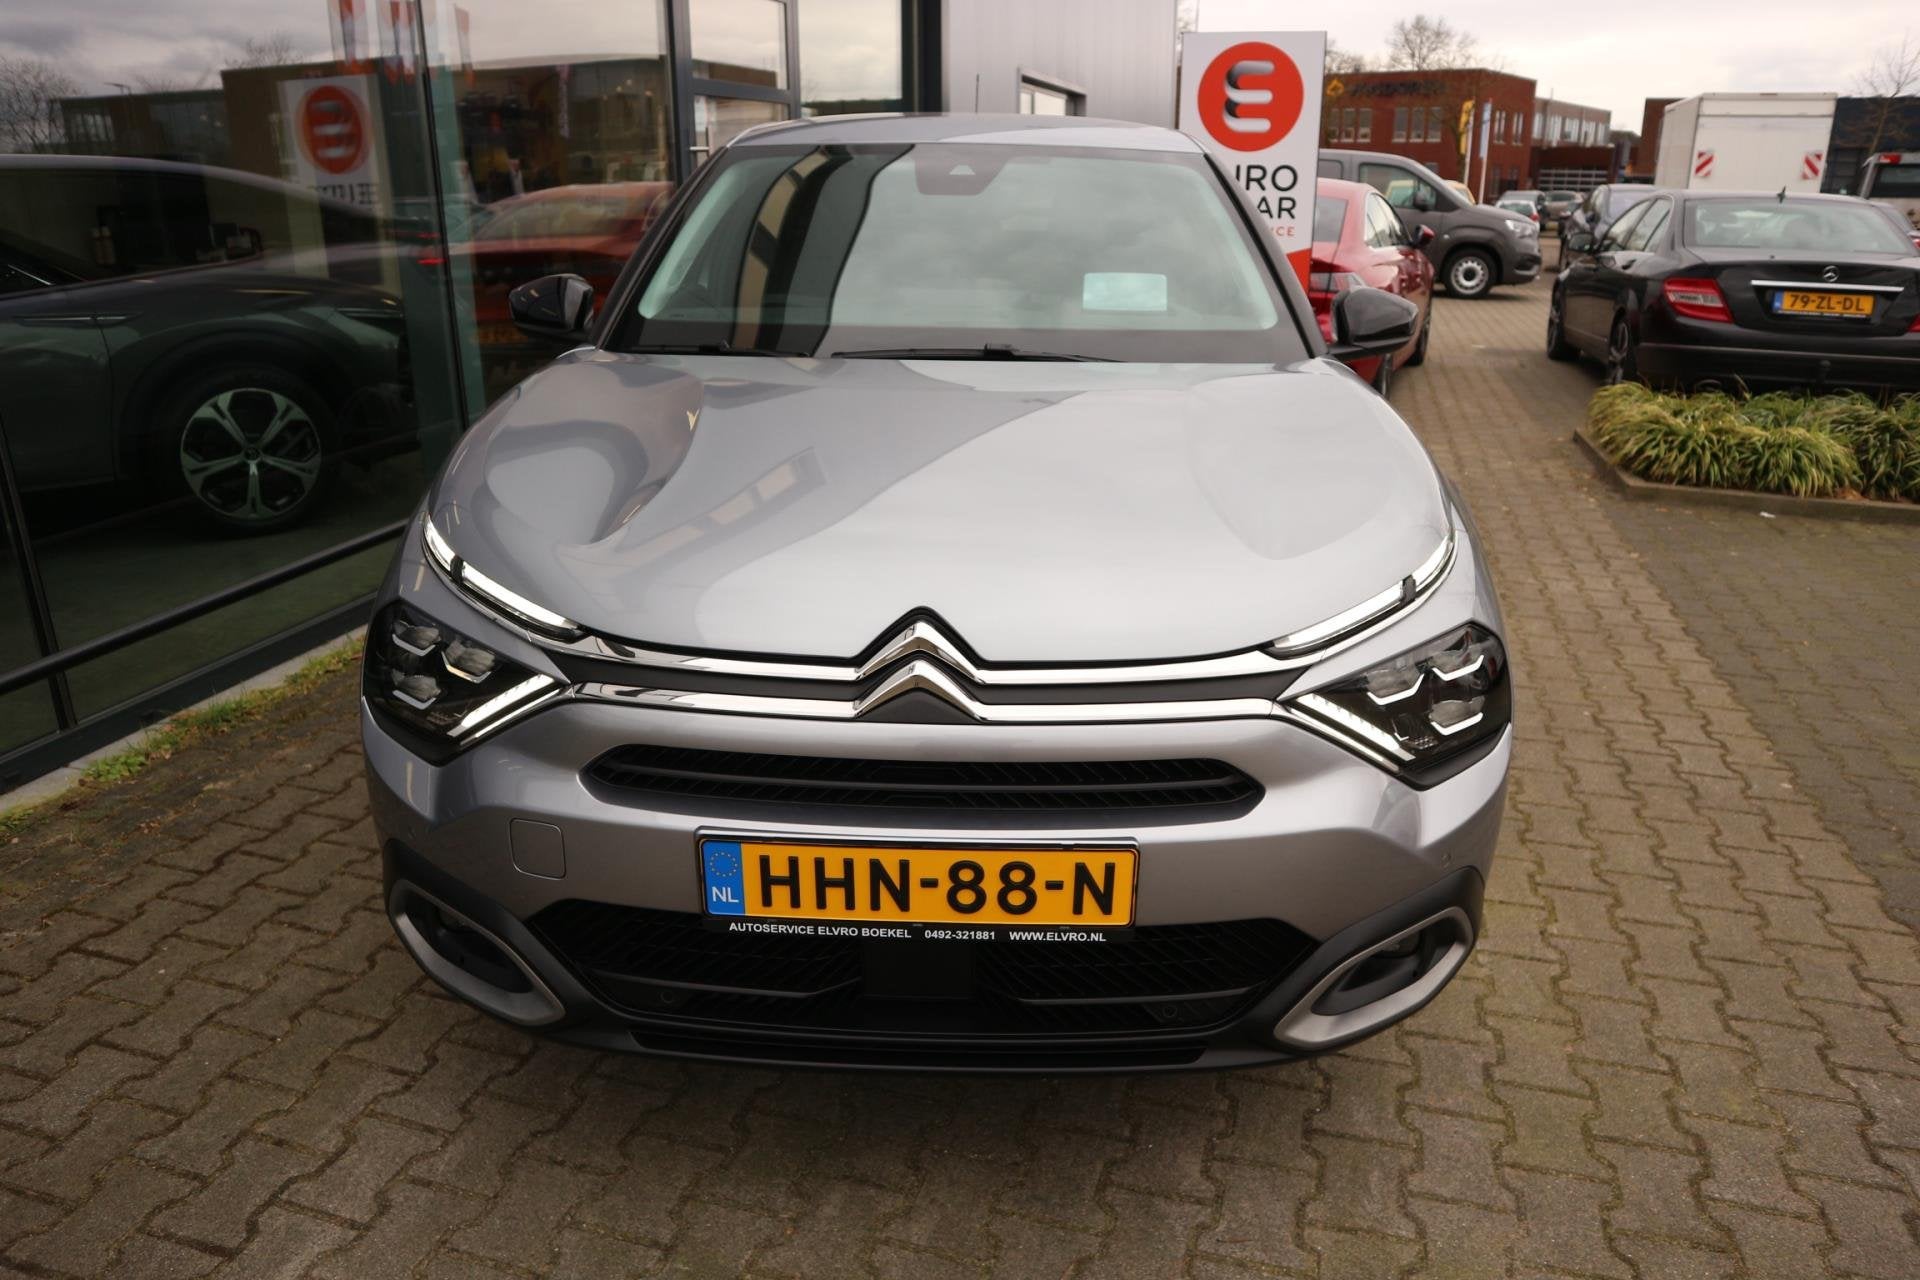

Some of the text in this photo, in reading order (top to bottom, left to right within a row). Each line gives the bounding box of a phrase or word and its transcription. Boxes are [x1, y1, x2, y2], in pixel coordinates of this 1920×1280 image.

[1790, 294, 1865, 312] 79-ZL-DL
[711, 886, 739, 903] NL
[759, 854, 1116, 916] HHN-88-N
[729, 921, 1107, 942] AUTOSERVICE ELVRO BOEKEL 0492-321881 WWW.ELVRO.NL
